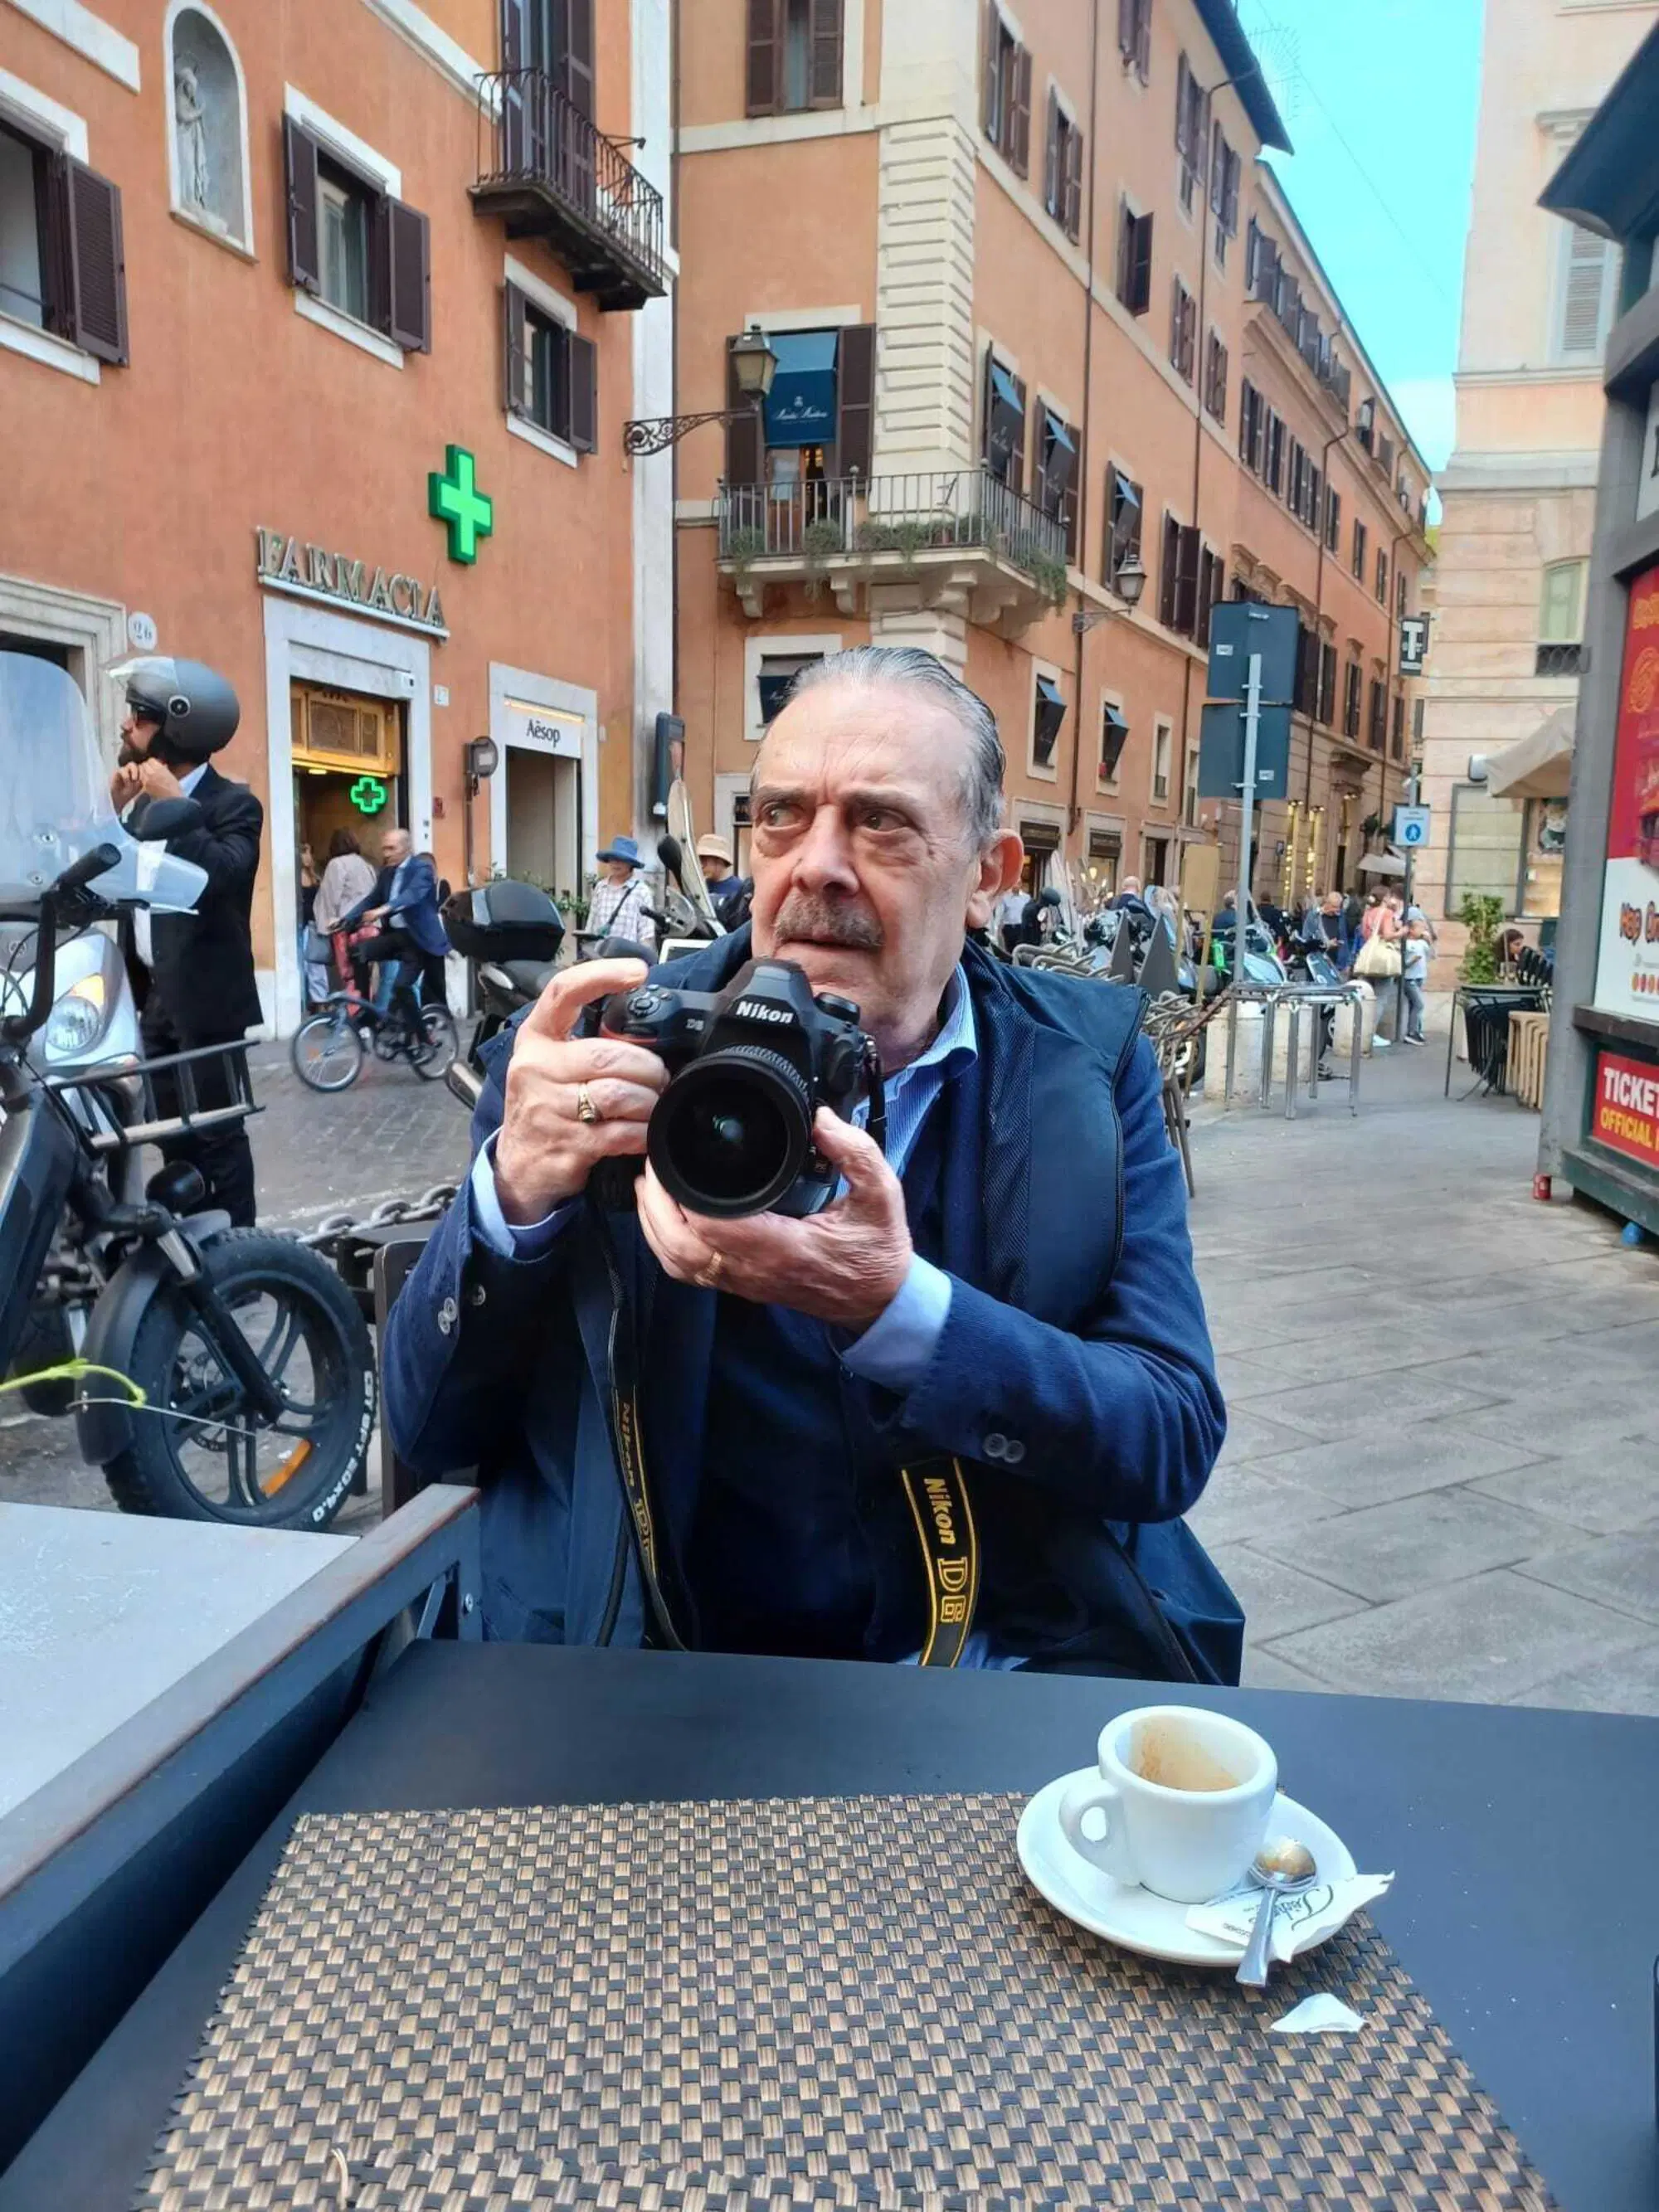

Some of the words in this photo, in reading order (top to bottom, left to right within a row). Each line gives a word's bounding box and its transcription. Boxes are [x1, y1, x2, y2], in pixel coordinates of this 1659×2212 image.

[255, 525, 446, 629] FARMACIA
[736, 1001, 795, 1024] Nikon
[1600, 1106, 1653, 1150] OFFICIAL
[923, 1477, 956, 1544] Nikon
